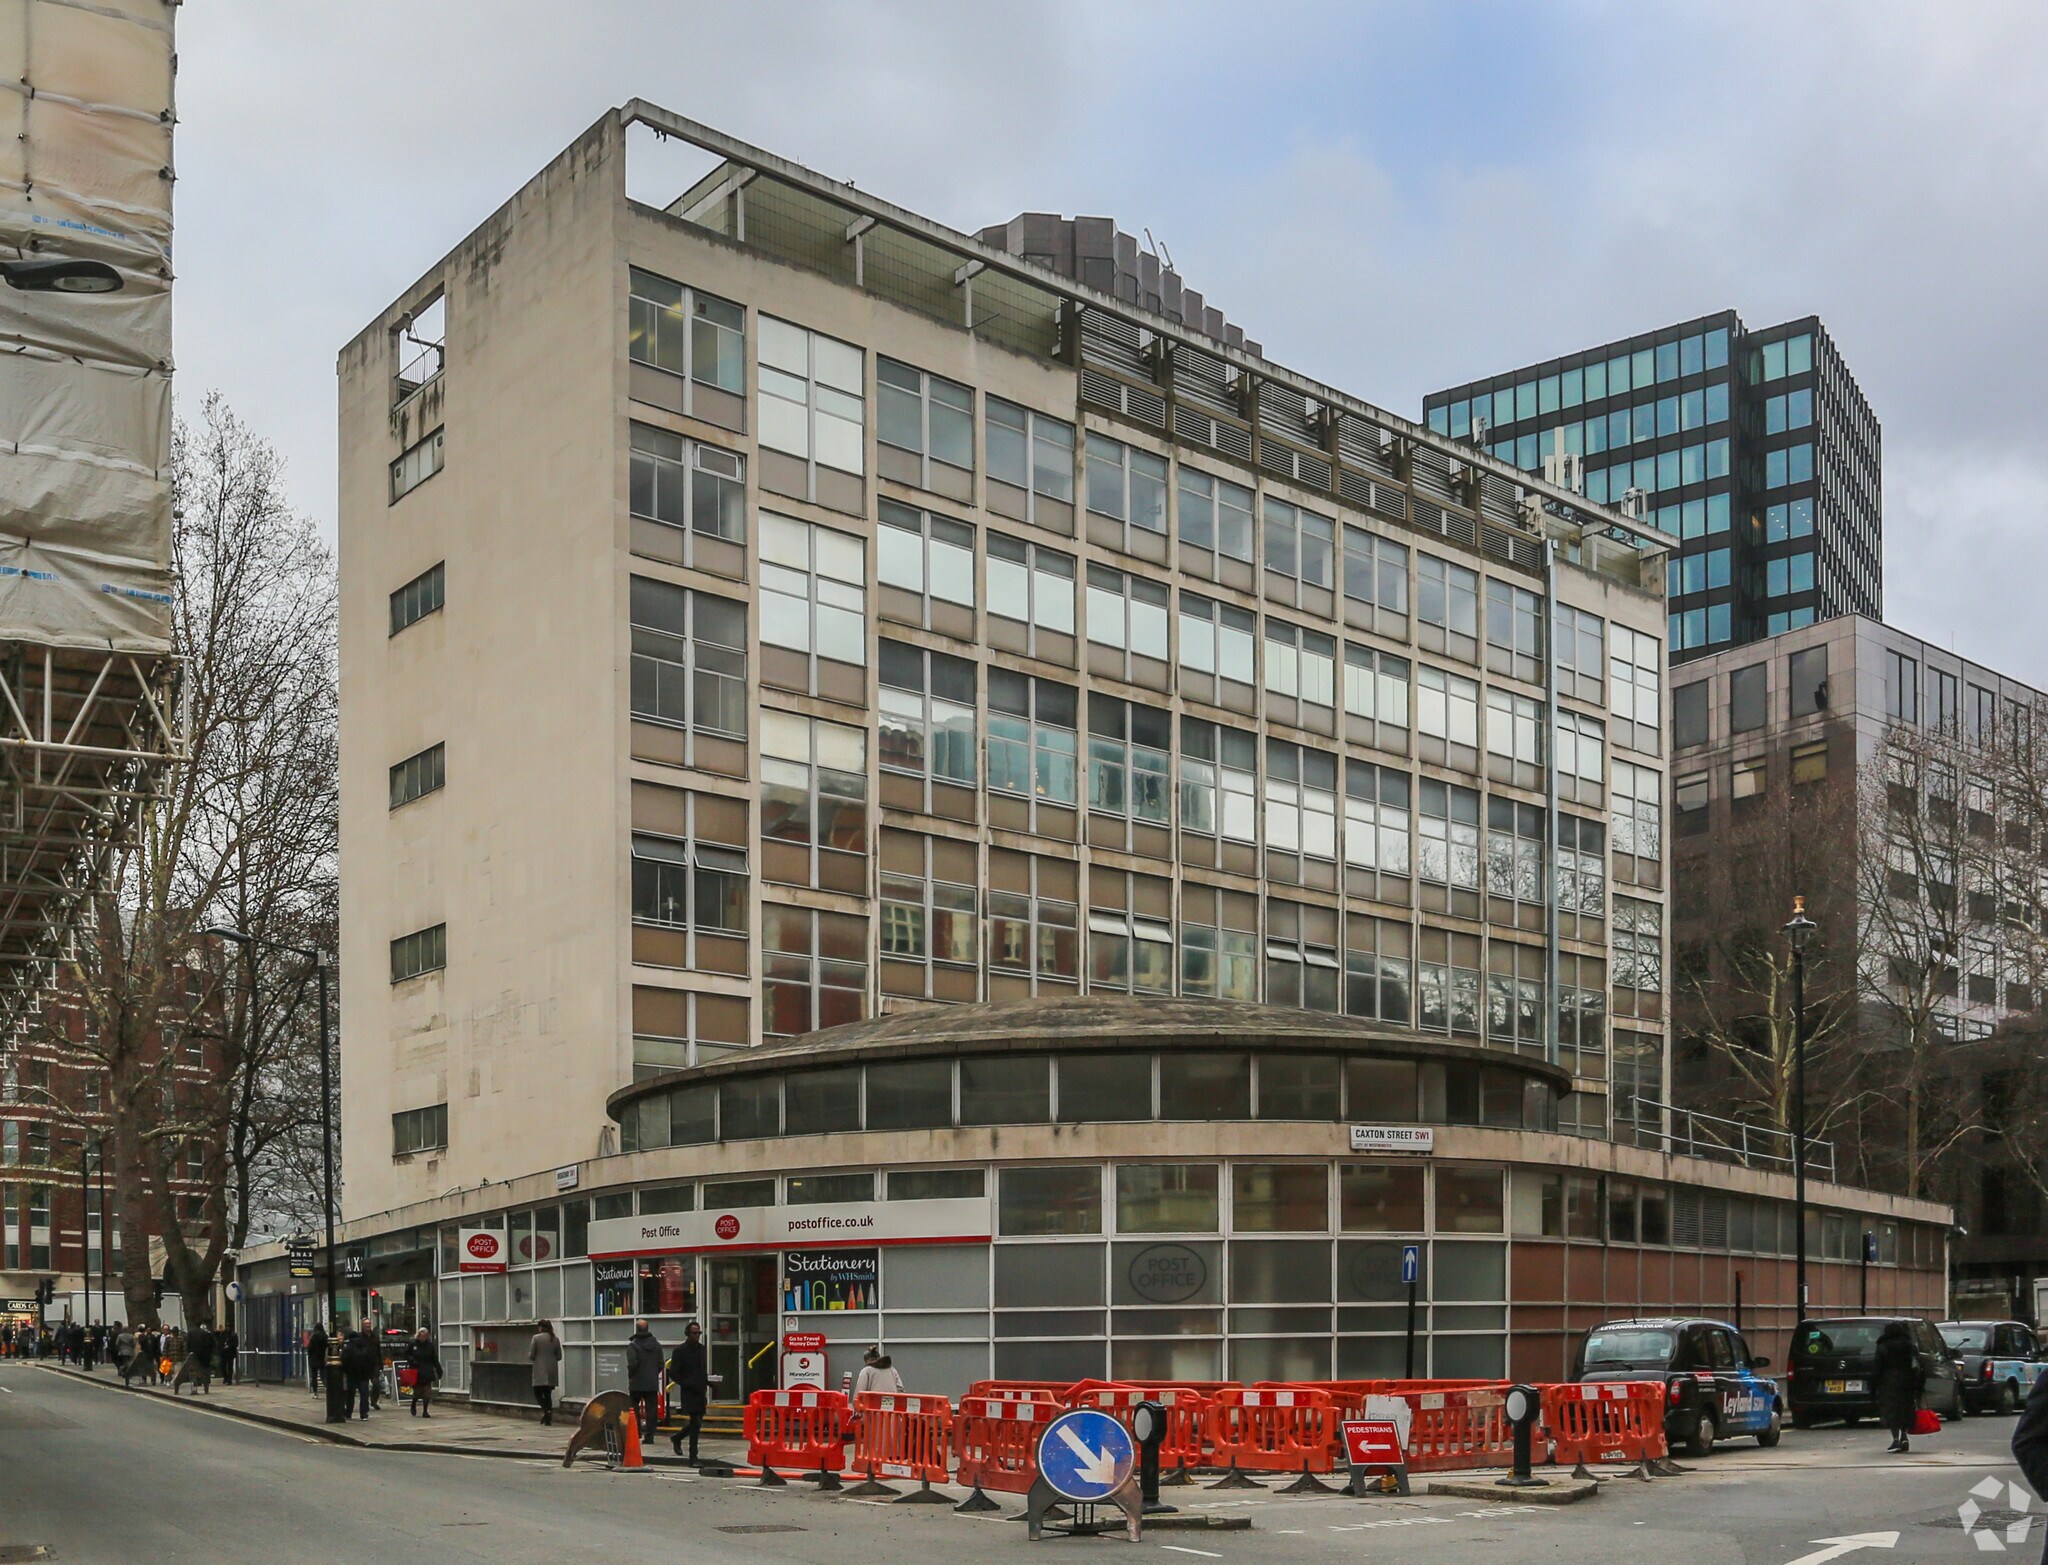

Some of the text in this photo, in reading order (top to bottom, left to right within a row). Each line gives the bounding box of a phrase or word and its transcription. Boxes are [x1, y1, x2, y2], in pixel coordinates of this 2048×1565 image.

[1356, 1130, 1429, 1140] CAXTON STREET SW1
[788, 1215, 874, 1232] postoffice.co.uk
[642, 1226, 680, 1238] Post Office
[788, 1252, 876, 1272] Stationery
[1148, 1257, 1189, 1271] POST
[838, 1272, 875, 1280] WHSmith
[1138, 1273, 1195, 1288] OFFICE
[1723, 1390, 1752, 1416] Leyland
